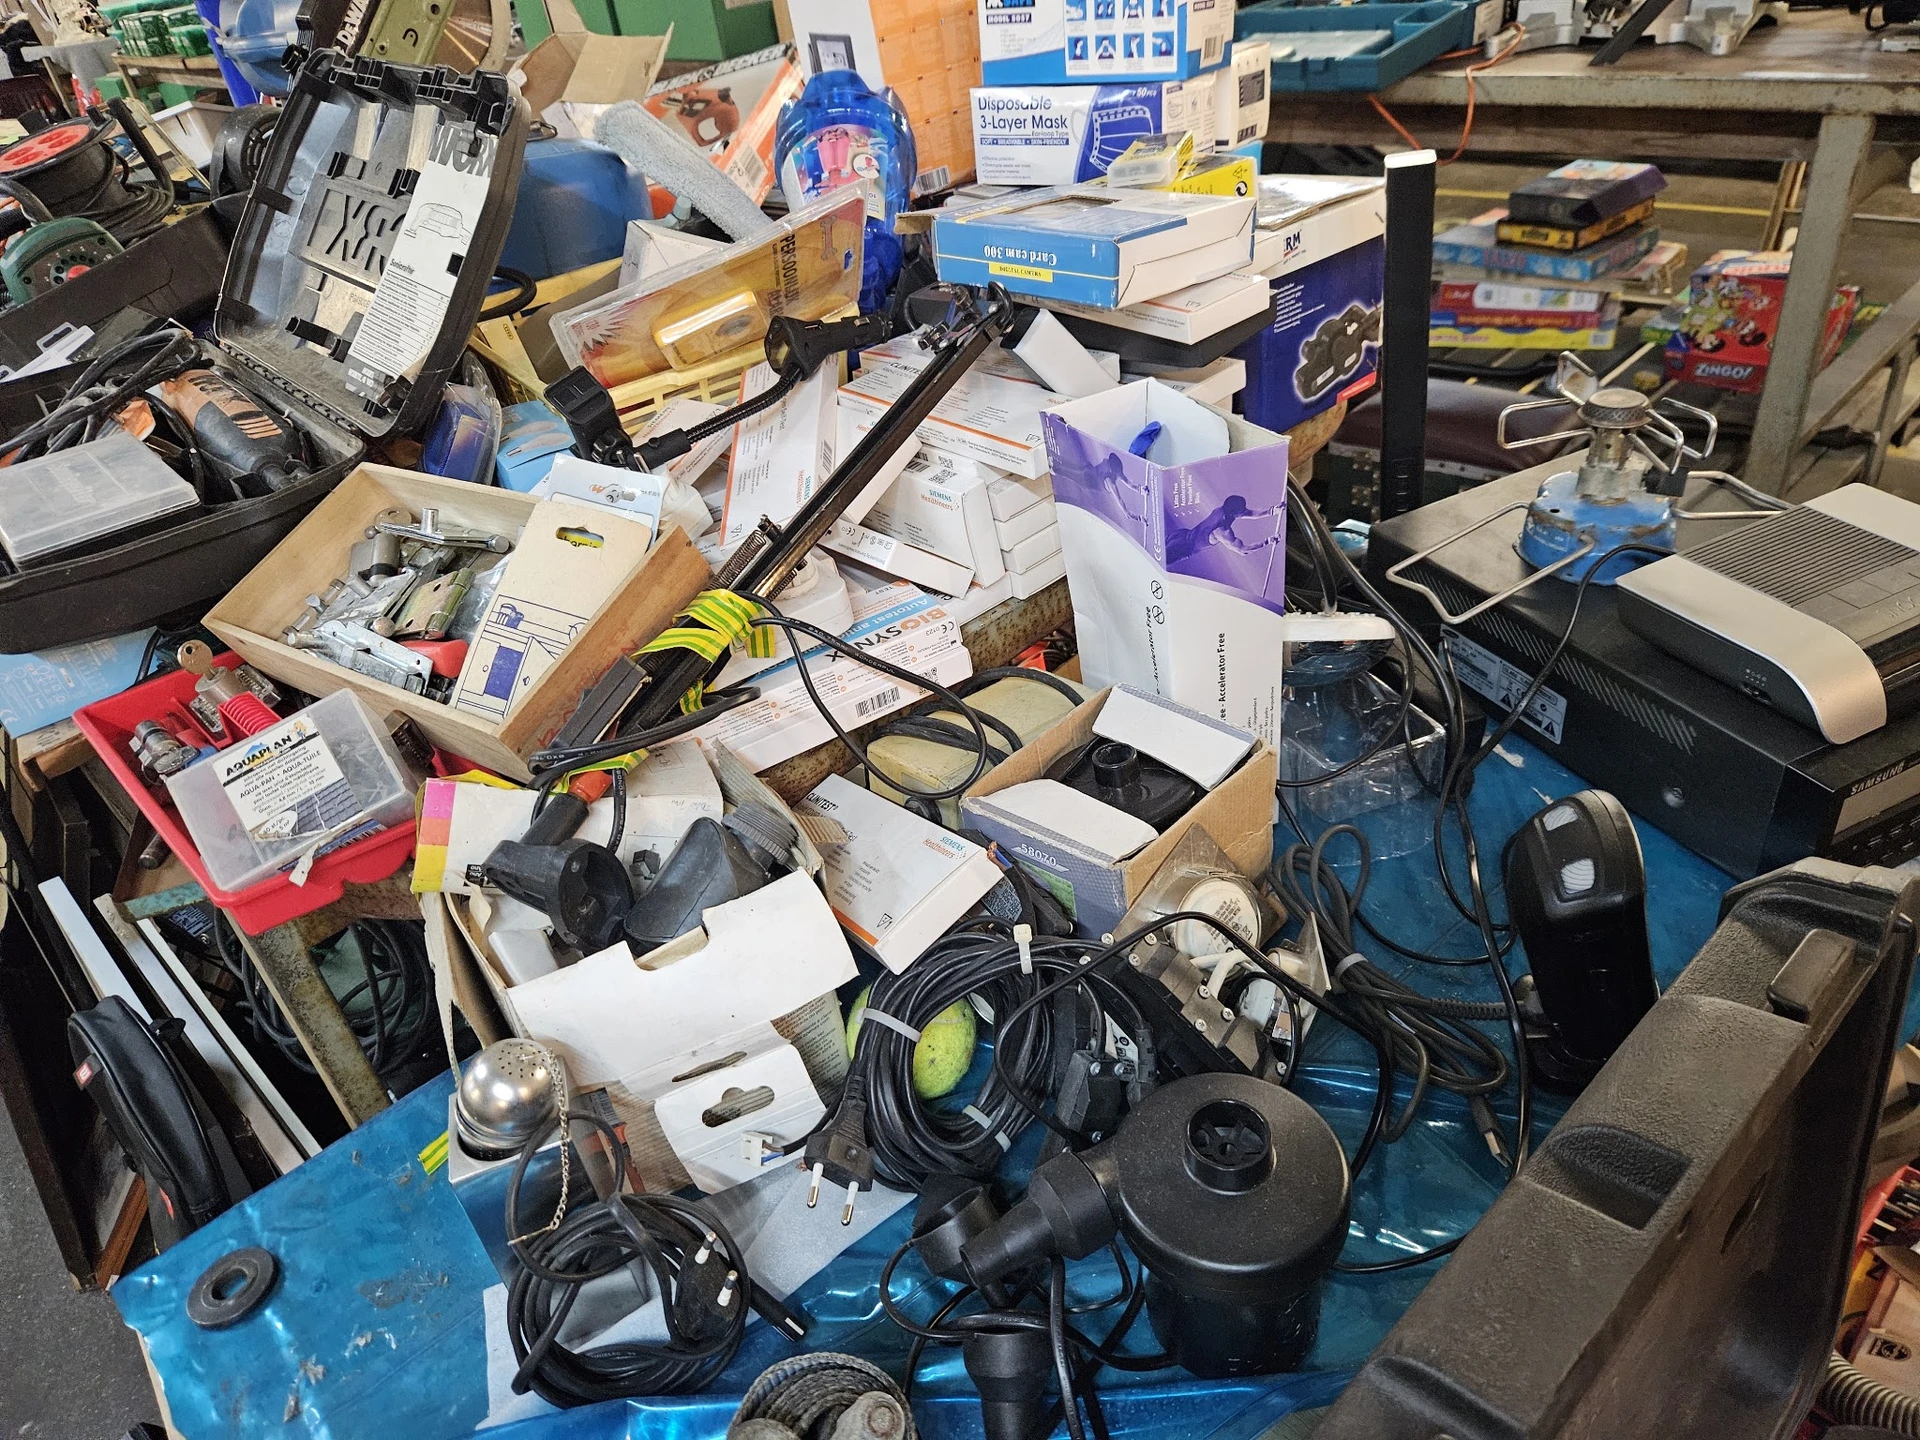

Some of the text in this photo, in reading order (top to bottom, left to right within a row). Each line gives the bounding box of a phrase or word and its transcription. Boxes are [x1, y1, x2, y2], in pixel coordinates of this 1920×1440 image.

[978, 95, 1052, 114] Disposable
[980, 114, 1068, 132] 3-Layer Mask
[984, 245, 1057, 266] Card cam 300
[1020, 268, 1042, 277] CAMERA
[1695, 362, 1754, 380] ZINGO!
[921, 494, 954, 511] Healthineers
[929, 489, 952, 502] SIEMENS
[875, 586, 893, 596] TEST
[872, 598, 928, 625] Autotest
[825, 608, 947, 663] BIOSYNX
[854, 652, 896, 674] WONDERFUL
[1149, 628, 1158, 679] Accelerator
[1218, 653, 1226, 702] Accelerator
[226, 735, 292, 776] AQUAPLAN
[240, 776, 276, 798] AQUA-PAN
[282, 750, 321, 774] AQUA-TUILE
[1850, 760, 1904, 796] SAMSUNG
[922, 838, 956, 859] Healthineers
[940, 836, 966, 852] SIEMENS
[1020, 842, 1058, 868] 58070
